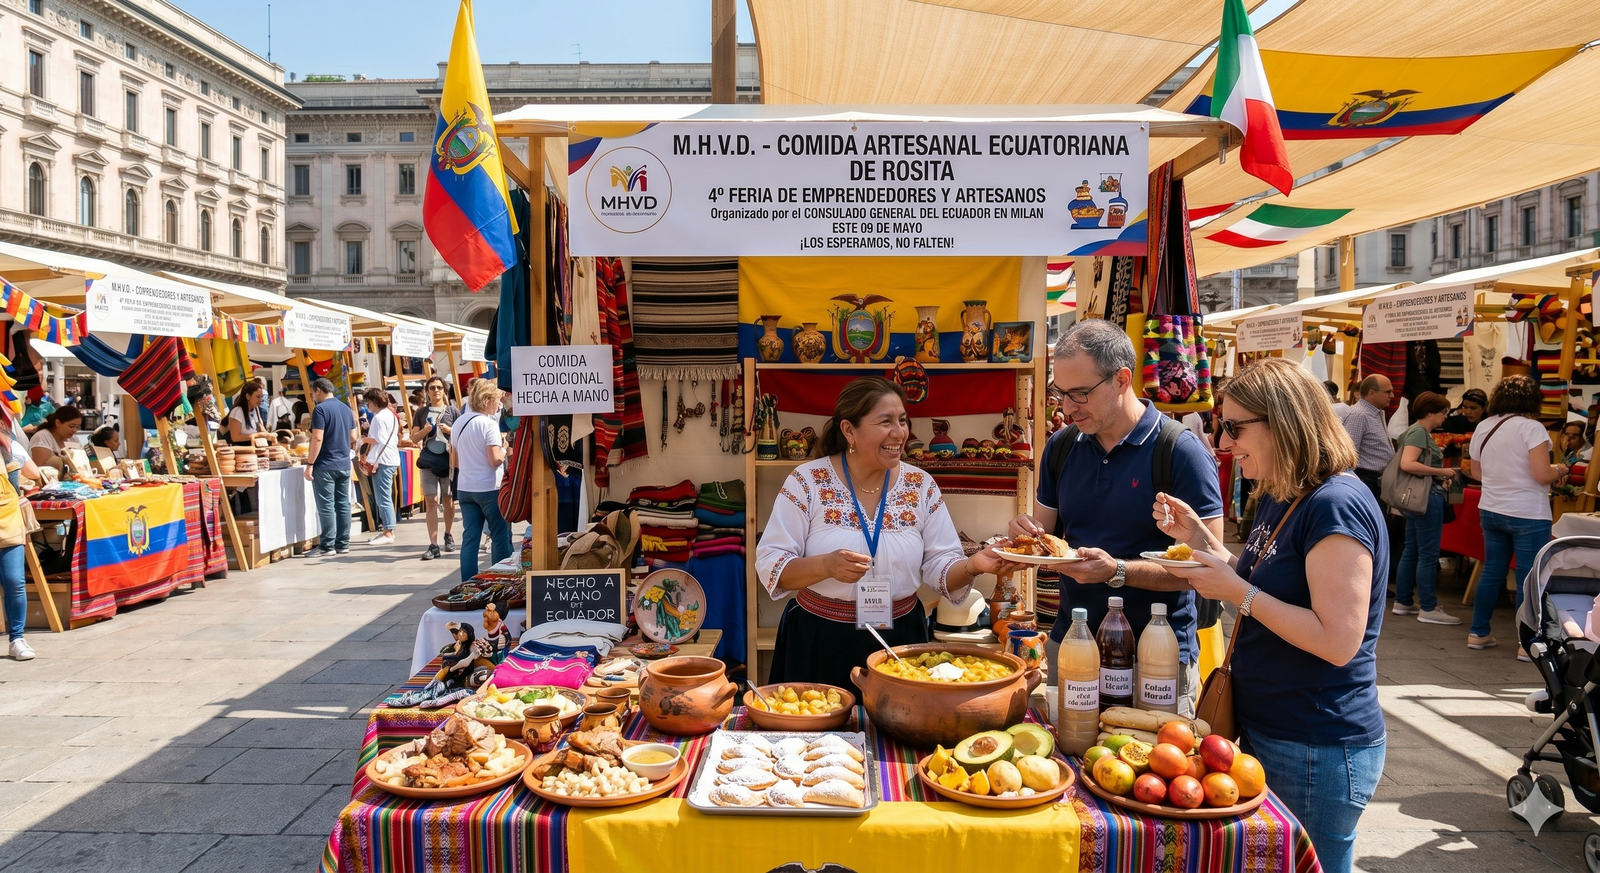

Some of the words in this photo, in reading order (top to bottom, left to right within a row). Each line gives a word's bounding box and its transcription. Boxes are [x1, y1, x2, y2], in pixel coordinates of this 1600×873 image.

[673, 134, 756, 156] M.H.V.D.
[777, 134, 859, 156] COMIDA
[863, 134, 983, 156] ARTESANAL
[989, 134, 1130, 156] ECUATORIANA
[850, 160, 876, 181] DE
[882, 159, 955, 182] ROSITA
[601, 195, 658, 210] MHVD
[707, 187, 725, 203] 4º
[729, 187, 774, 203] FERIA
[777, 187, 798, 203] DE
[802, 187, 937, 204] EMPRENDEDORES
[940, 187, 951, 203] Y
[954, 187, 1046, 204] ARTESANOS
[710, 207, 769, 221] Organizado
[771, 209, 790, 221] por
[792, 207, 801, 219] el
[804, 207, 867, 219] CONSULADO
[869, 207, 917, 219] GENERAL
[919, 207, 940, 219] DEL
[942, 207, 991, 219] ECUADOR
[994, 207, 1008, 219] EN
[1010, 207, 1044, 219] MILAN
[832, 222, 858, 234] ESTE
[860, 222, 874, 234] 09
[876, 222, 890, 234] DE
[892, 222, 923, 234] MAYO
[800, 237, 824, 251] ¡LOS
[826, 237, 893, 251] ESPERAMOS,
[895, 237, 911, 249] NO
[913, 237, 954, 249] FALTEN!
[1437, 291, 1467, 303] ARTESANOS
[538, 354, 588, 368] COMIDA
[522, 371, 604, 386] TRADICIONAL
[517, 390, 559, 404] HECHA
[561, 389, 571, 403] A
[573, 388, 610, 403] MANO
[604, 576, 614, 587] A
[543, 591, 552, 602] A
[559, 590, 602, 601] MANO
[546, 609, 615, 622] ECUADOR
[1104, 674, 1129, 683] Chicha
[1144, 683, 1172, 692] Colada
